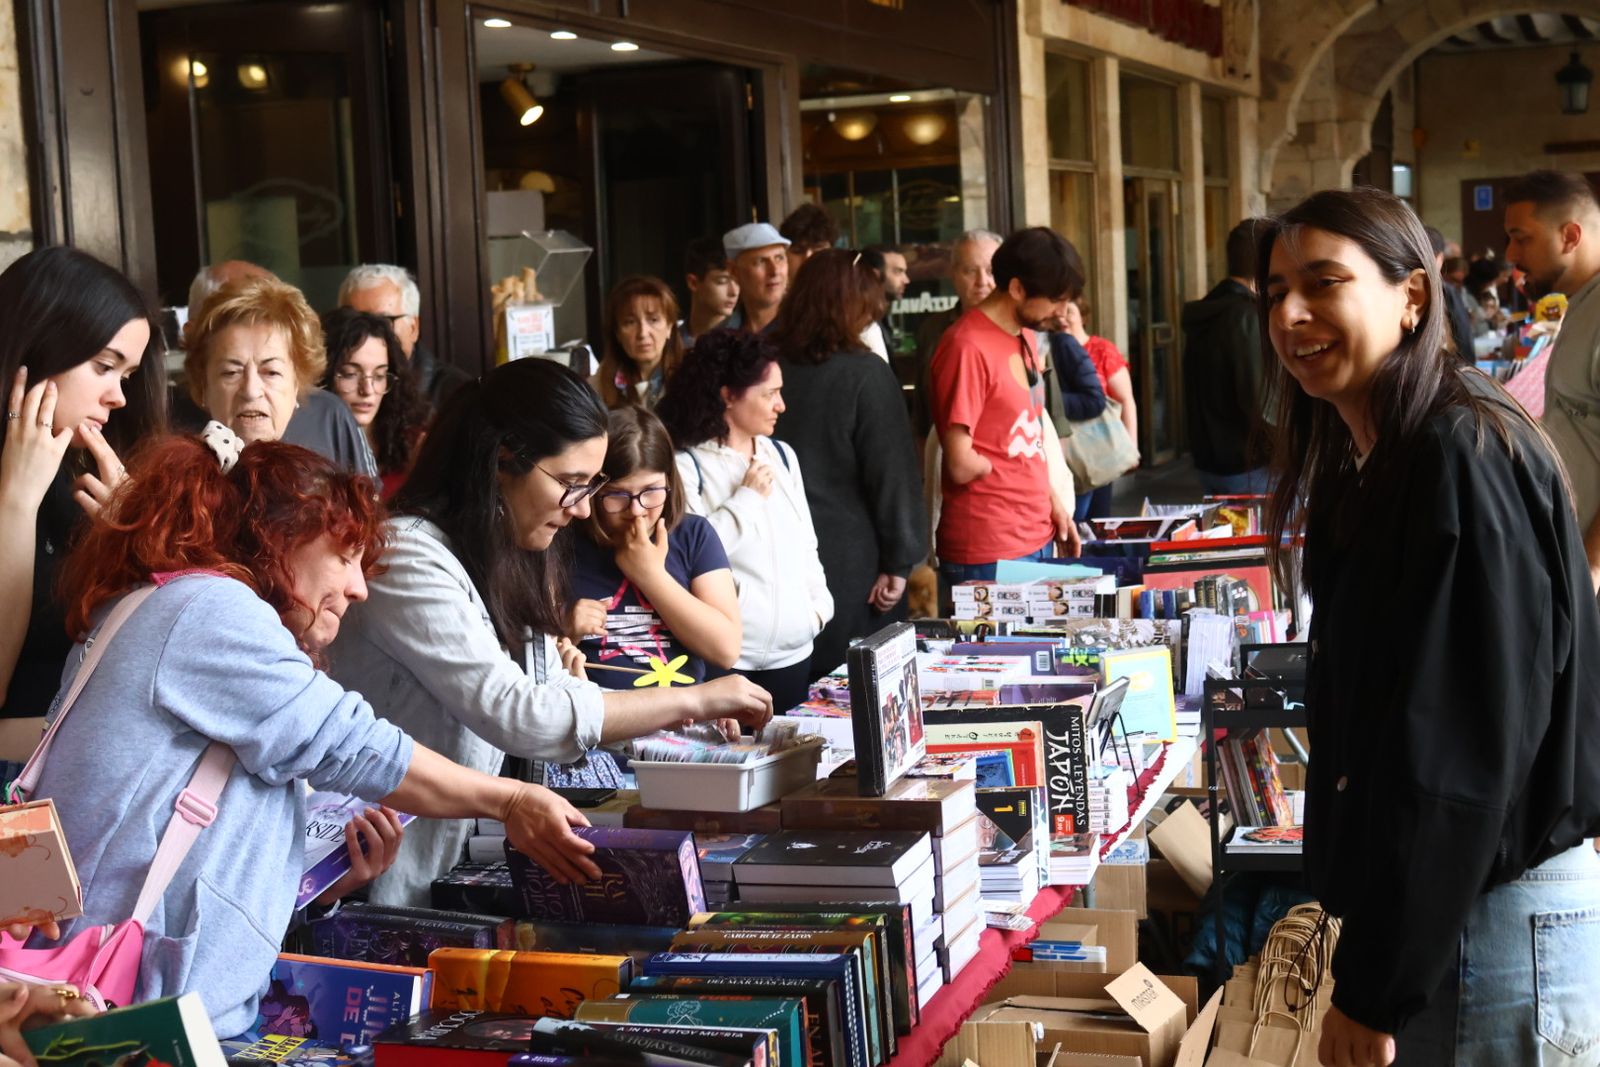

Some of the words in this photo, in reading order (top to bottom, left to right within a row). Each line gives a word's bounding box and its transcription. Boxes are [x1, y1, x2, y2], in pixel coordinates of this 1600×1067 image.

[1070, 716, 1082, 754] MITOS
[1073, 765, 1086, 826] LEYENDAS
[993, 804, 1014, 813] 1
[730, 978, 752, 986] MAR
[391, 991, 401, 1012] ALI
[626, 1035, 666, 1051] HOJAS
